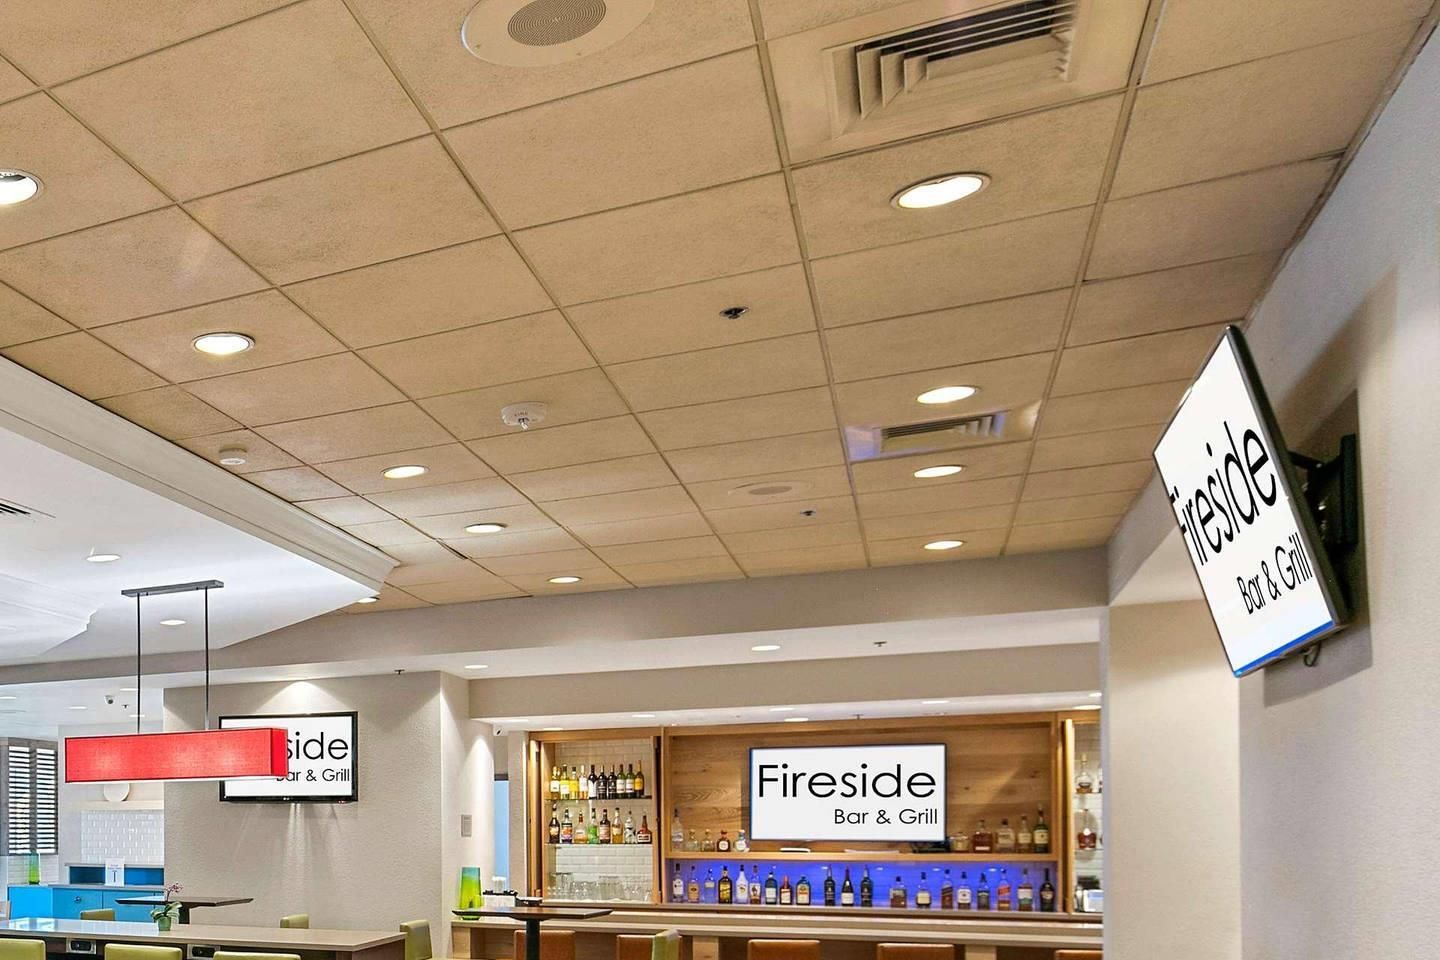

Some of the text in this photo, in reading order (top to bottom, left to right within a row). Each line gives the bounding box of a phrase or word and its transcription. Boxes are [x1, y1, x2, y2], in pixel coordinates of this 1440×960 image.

[1237, 532, 1313, 614] Bar & Grill
[287, 731, 349, 760] side
[276, 768, 350, 782] ar & Grill
[758, 763, 937, 799] Fireside
[834, 808, 938, 825] Bar & Grill
